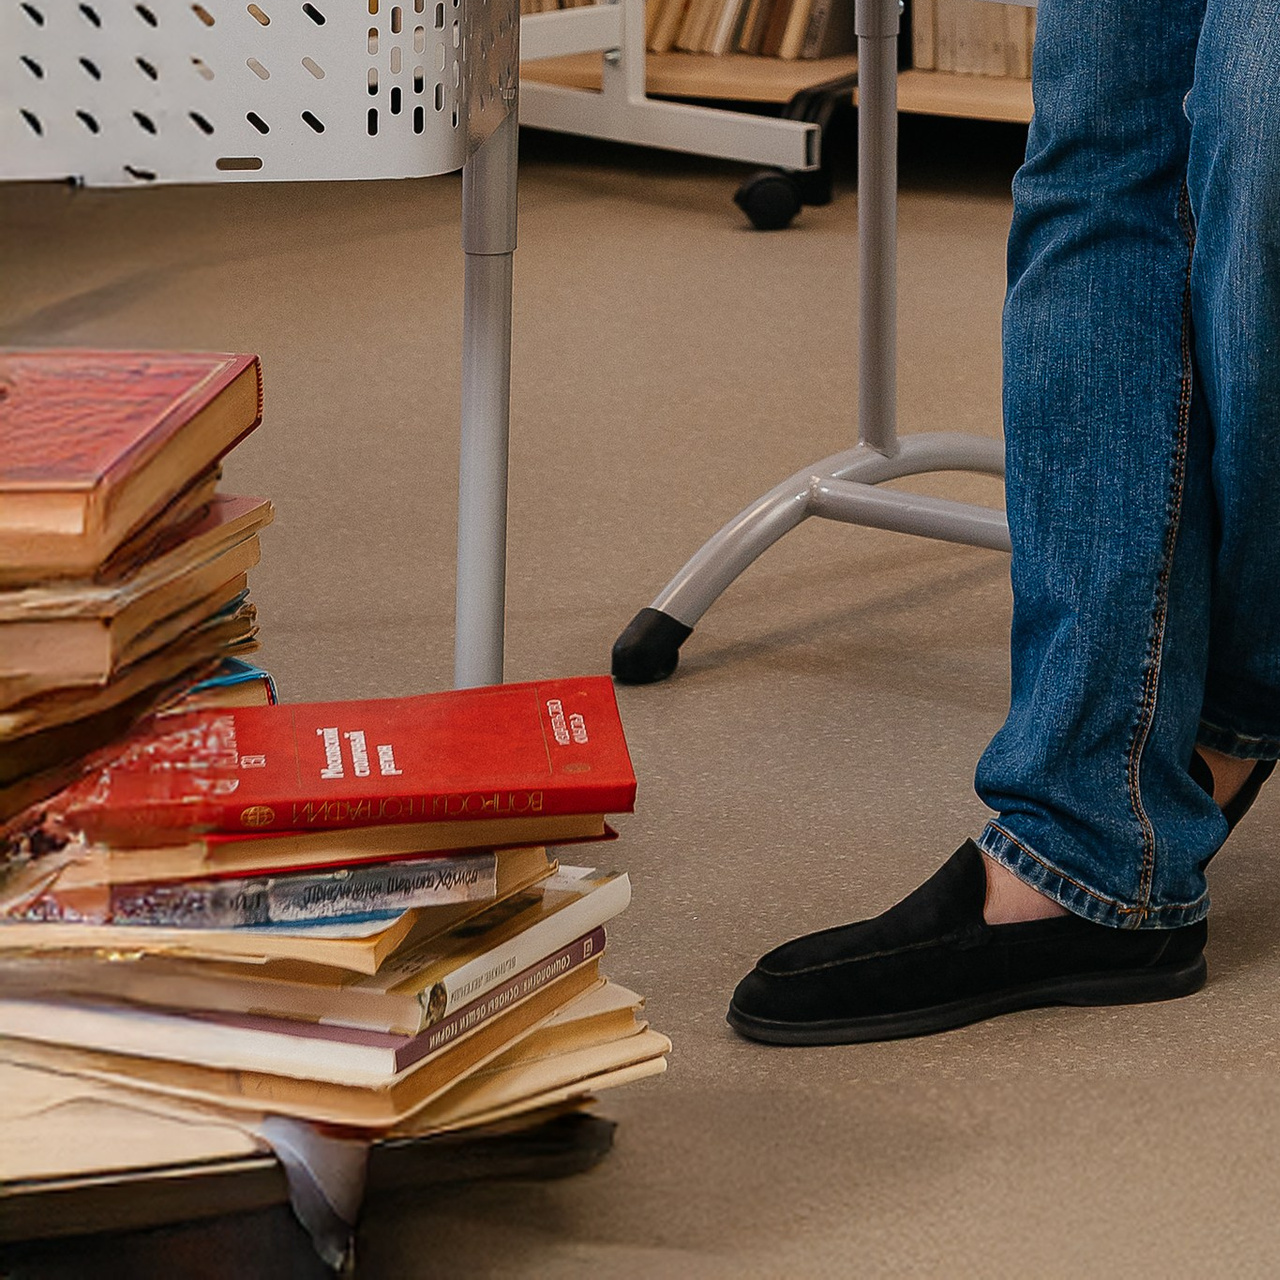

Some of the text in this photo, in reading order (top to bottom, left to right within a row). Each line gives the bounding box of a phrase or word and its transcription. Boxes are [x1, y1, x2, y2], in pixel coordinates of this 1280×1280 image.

[316, 726, 345, 780] Московский
[343, 729, 371, 778] столичный
[376, 743, 403, 778] регион
[290, 790, 544, 826] ВОПРОСЫ ГЕОГРАФИИ
[386, 874, 435, 899] Шерлока
[434, 868, 479, 892] Холмса
[488, 984, 520, 1011] ОСНОВЫ
[429, 1023, 458, 1050] ТЕОРИИ
